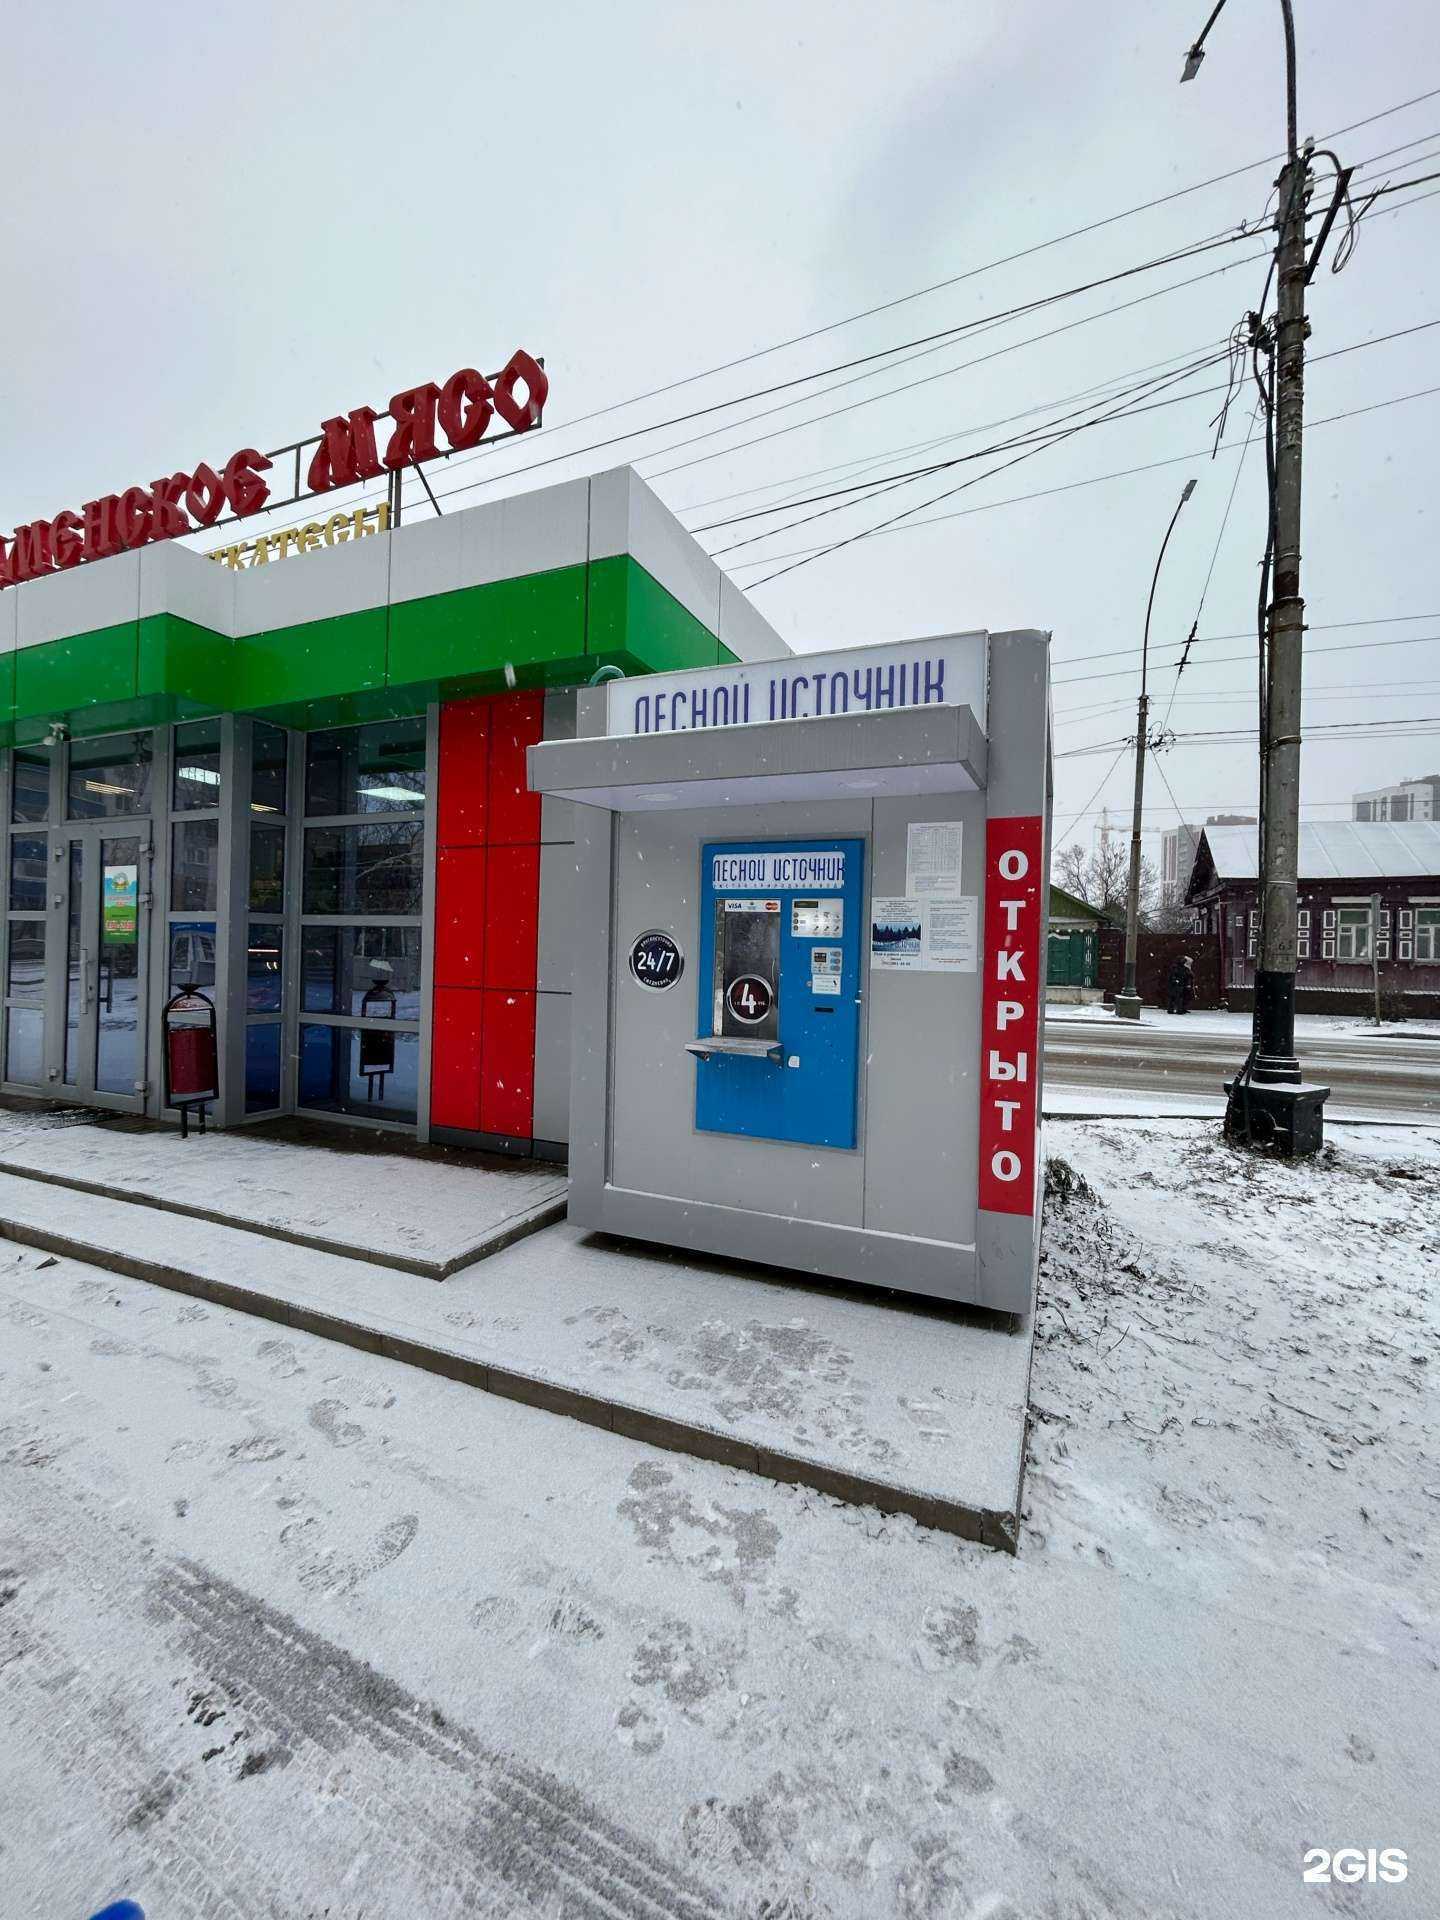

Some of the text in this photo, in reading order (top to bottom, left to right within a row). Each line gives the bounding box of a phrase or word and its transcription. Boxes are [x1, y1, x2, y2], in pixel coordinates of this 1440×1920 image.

[308, 349, 549, 493] МЯСО
[769, 659, 945, 721] ИСТОЧНИК
[773, 858, 845, 881] ИСТОЧНИК
[637, 950, 675, 972] 24/7
[741, 983, 757, 1014] 4
[988, 849, 1030, 1182] ОТКРЫТО
